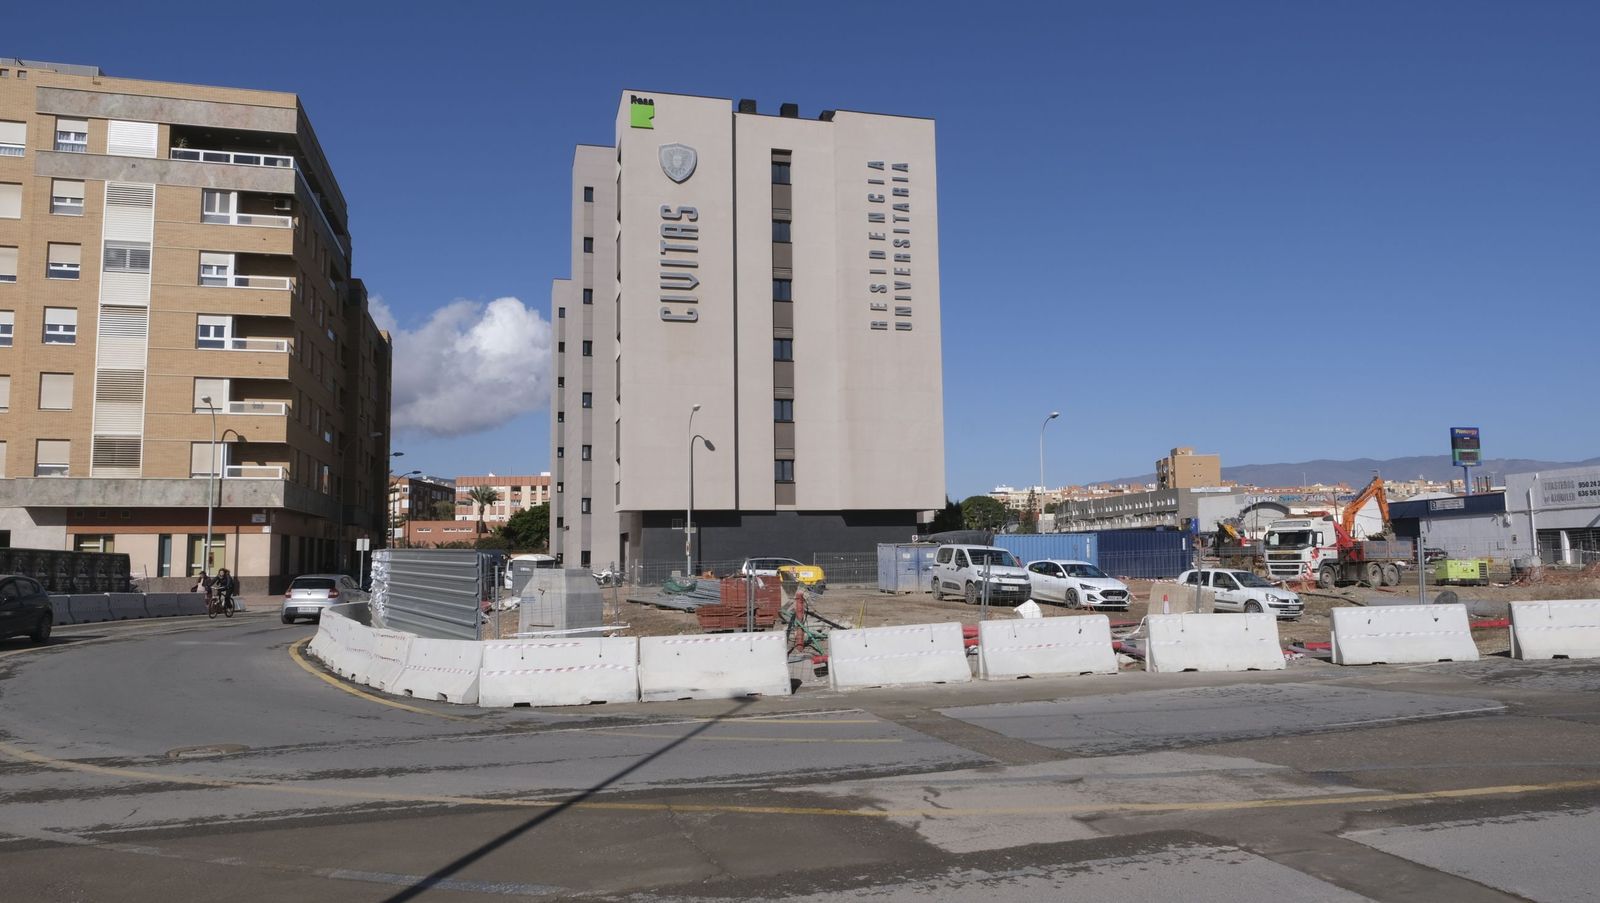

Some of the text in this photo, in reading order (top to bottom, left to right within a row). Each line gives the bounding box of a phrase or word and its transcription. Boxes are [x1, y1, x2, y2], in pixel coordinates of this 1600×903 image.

[660, 204, 699, 323] CIVITAS
[867, 161, 888, 330] RESIDENCIA
[892, 163, 912, 331] UNIVERSITARIA
